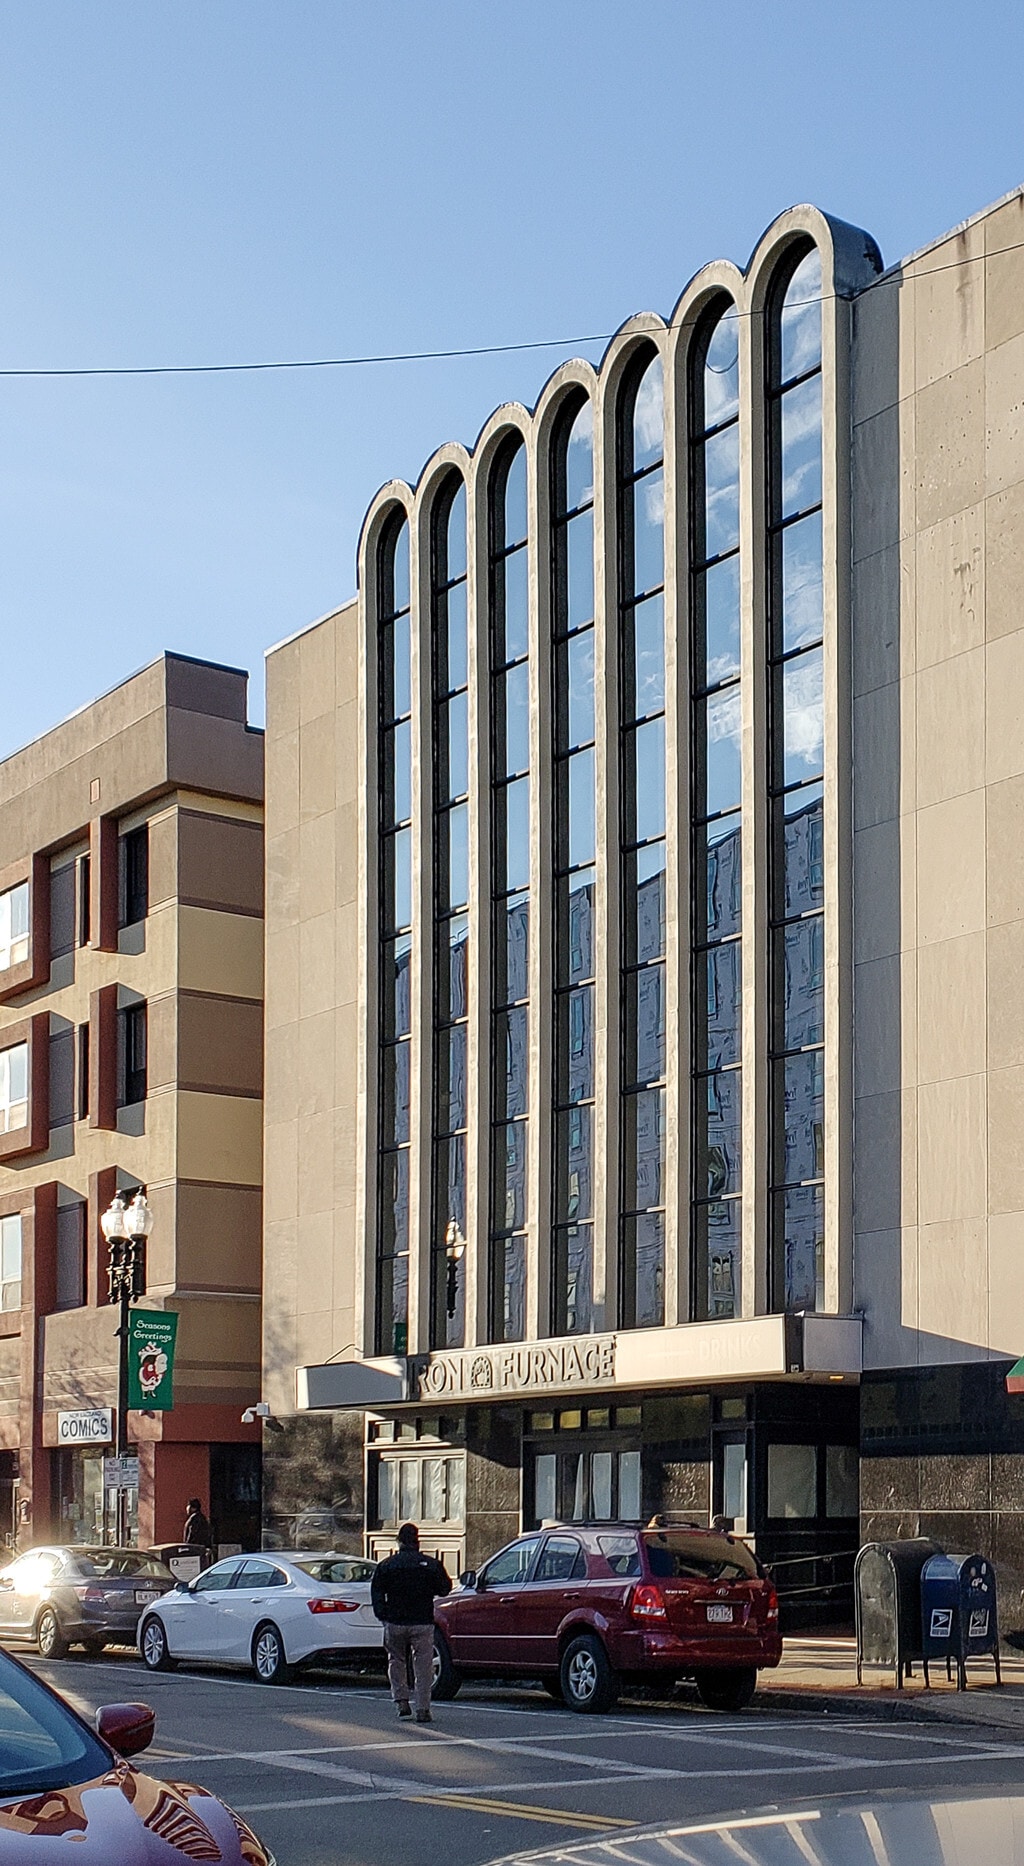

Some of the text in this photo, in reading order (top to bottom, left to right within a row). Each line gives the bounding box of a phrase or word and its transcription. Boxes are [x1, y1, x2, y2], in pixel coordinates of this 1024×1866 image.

[136, 1319, 171, 1331] Seasons
[133, 1329, 173, 1343] Greetings
[503, 1340, 615, 1388] FURNACE
[61, 1417, 108, 1438] COMICS
